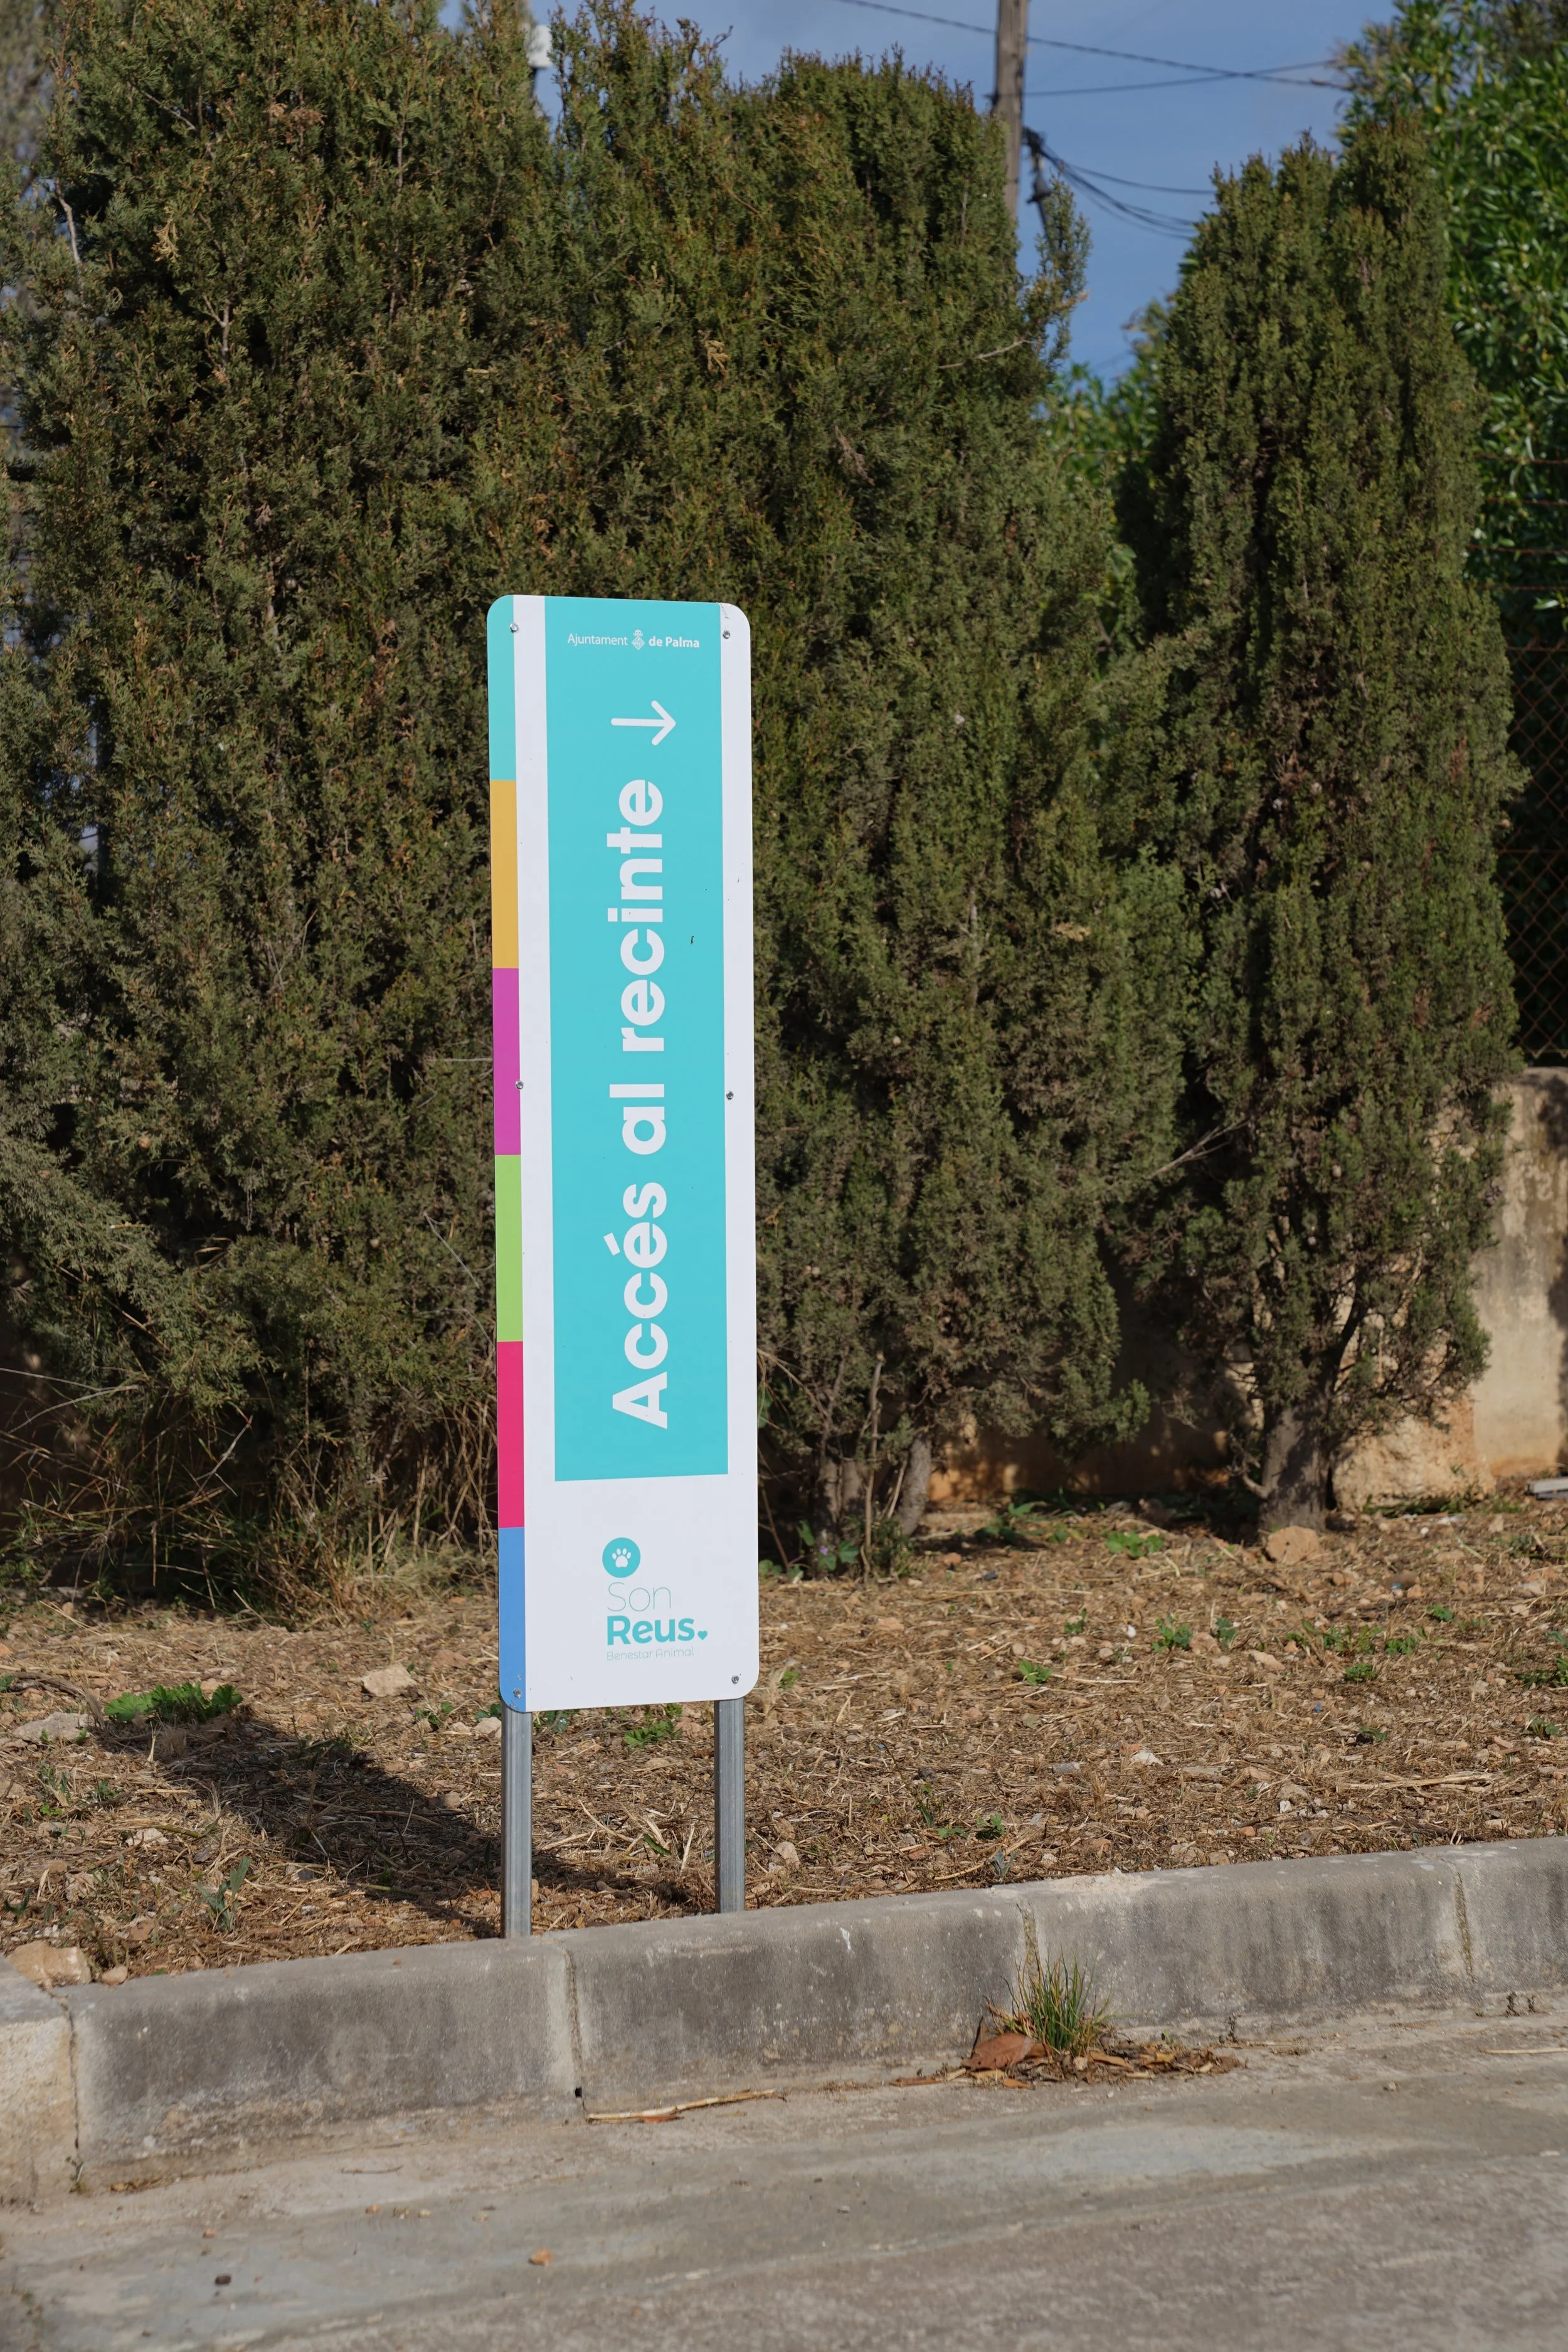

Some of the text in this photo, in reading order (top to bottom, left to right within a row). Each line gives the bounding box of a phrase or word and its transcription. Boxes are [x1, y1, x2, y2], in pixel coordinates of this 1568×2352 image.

[567, 632, 701, 649] Ajuntament de Palma
[603, 779, 669, 1430] Accés al recinte
[607, 1581, 671, 1612] Son
[607, 1646, 695, 1661] Benestar Animal
